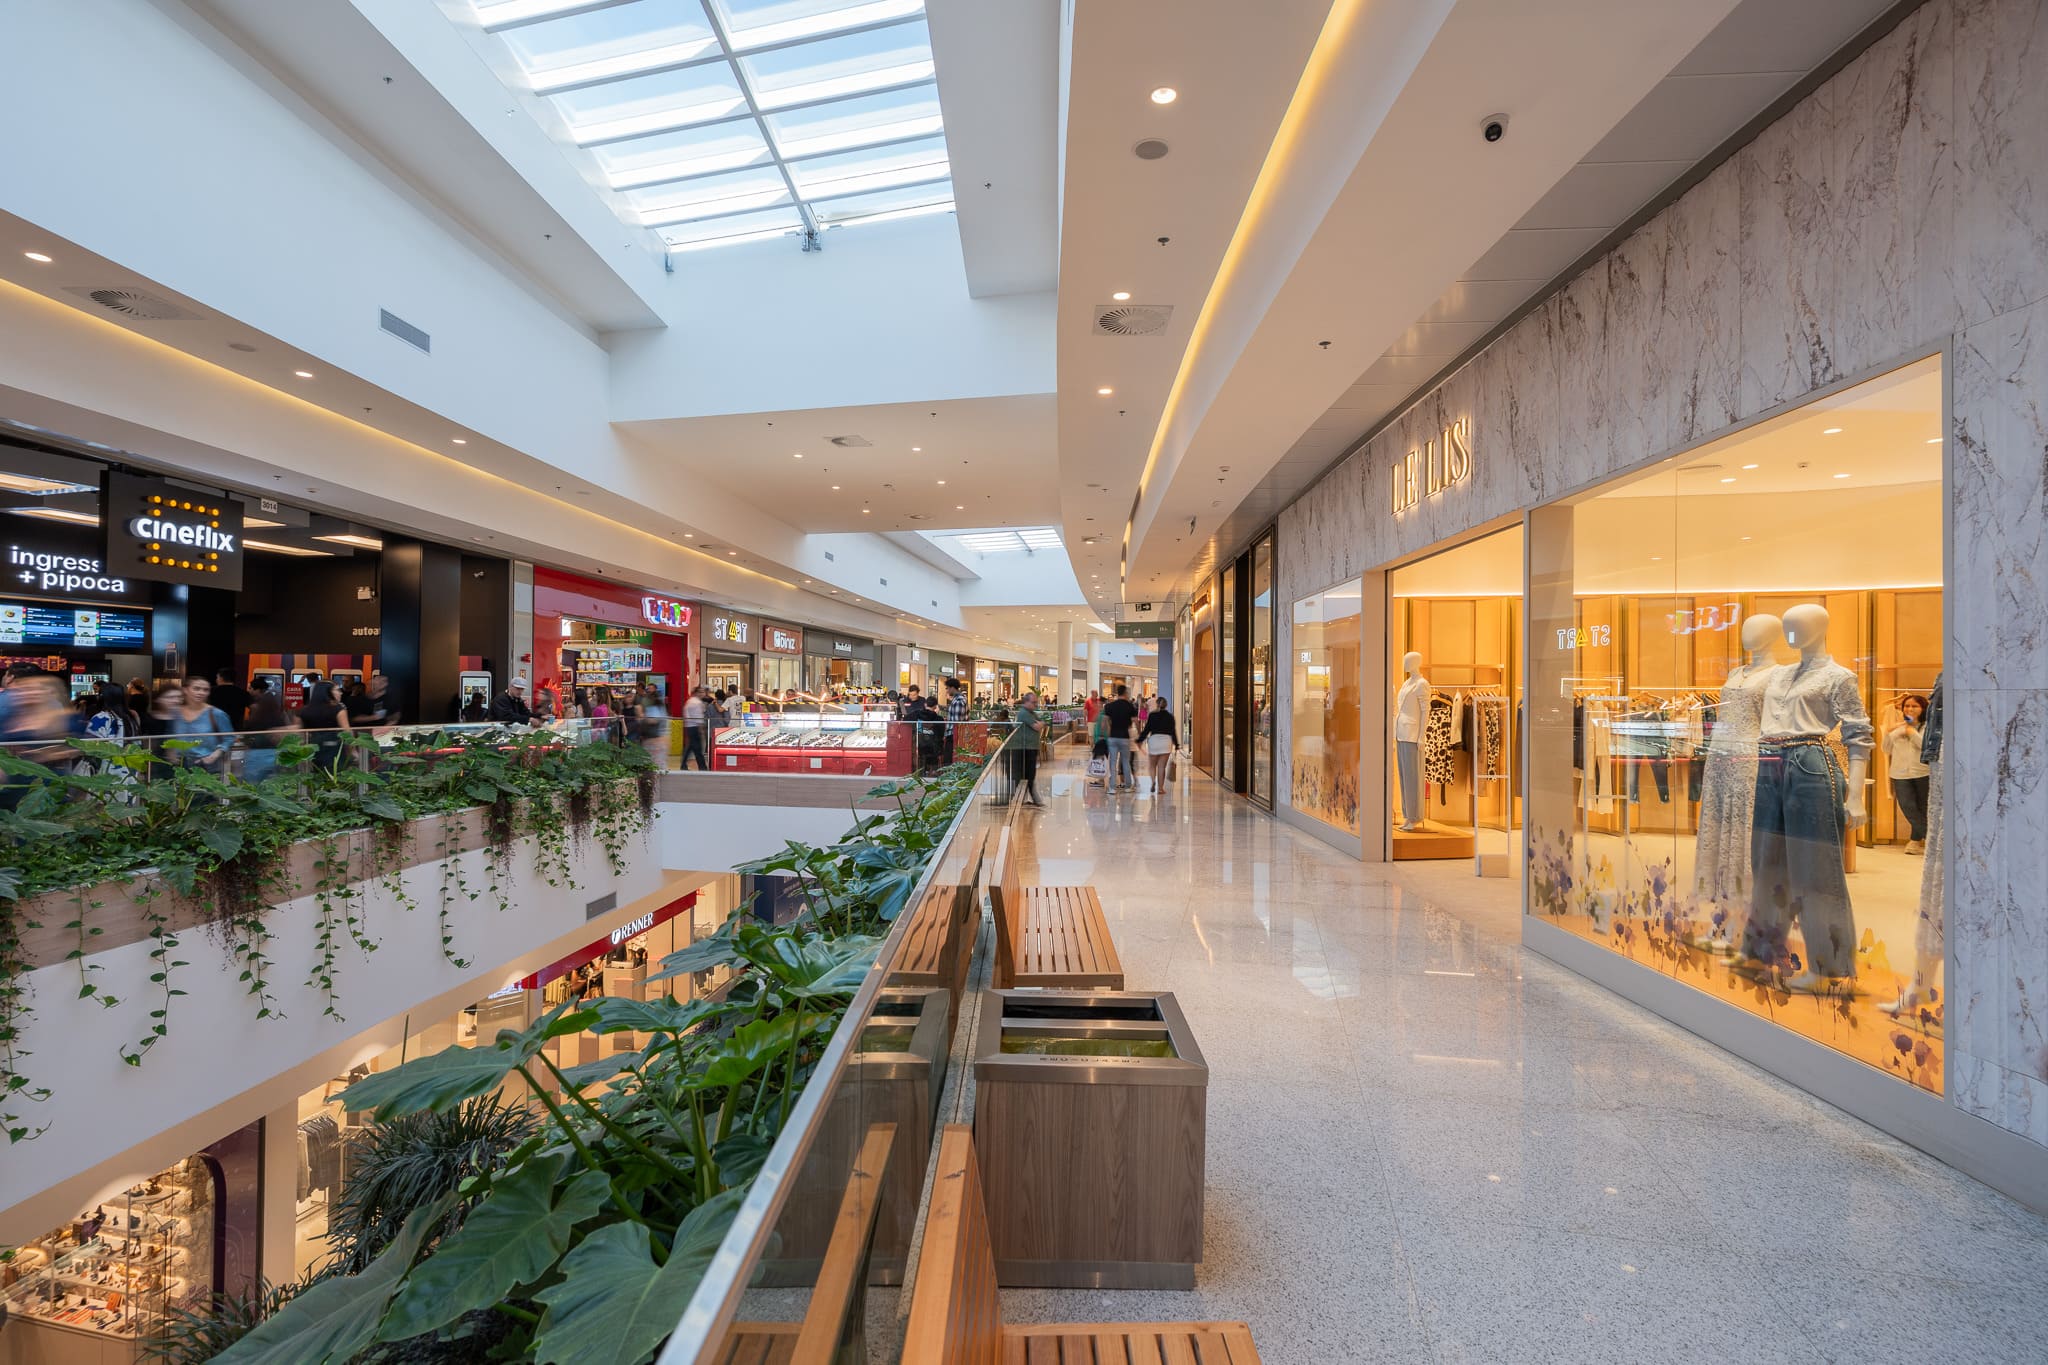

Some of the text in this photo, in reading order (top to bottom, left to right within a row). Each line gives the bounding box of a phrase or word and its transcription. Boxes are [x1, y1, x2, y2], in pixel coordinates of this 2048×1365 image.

[1391, 418, 1470, 515] LE LIS
[133, 517, 235, 553] cineflix
[41, 571, 125, 593] pipoca
[352, 626, 380, 637] autoa
[714, 617, 748, 644] START
[621, 911, 654, 940] RENNER
